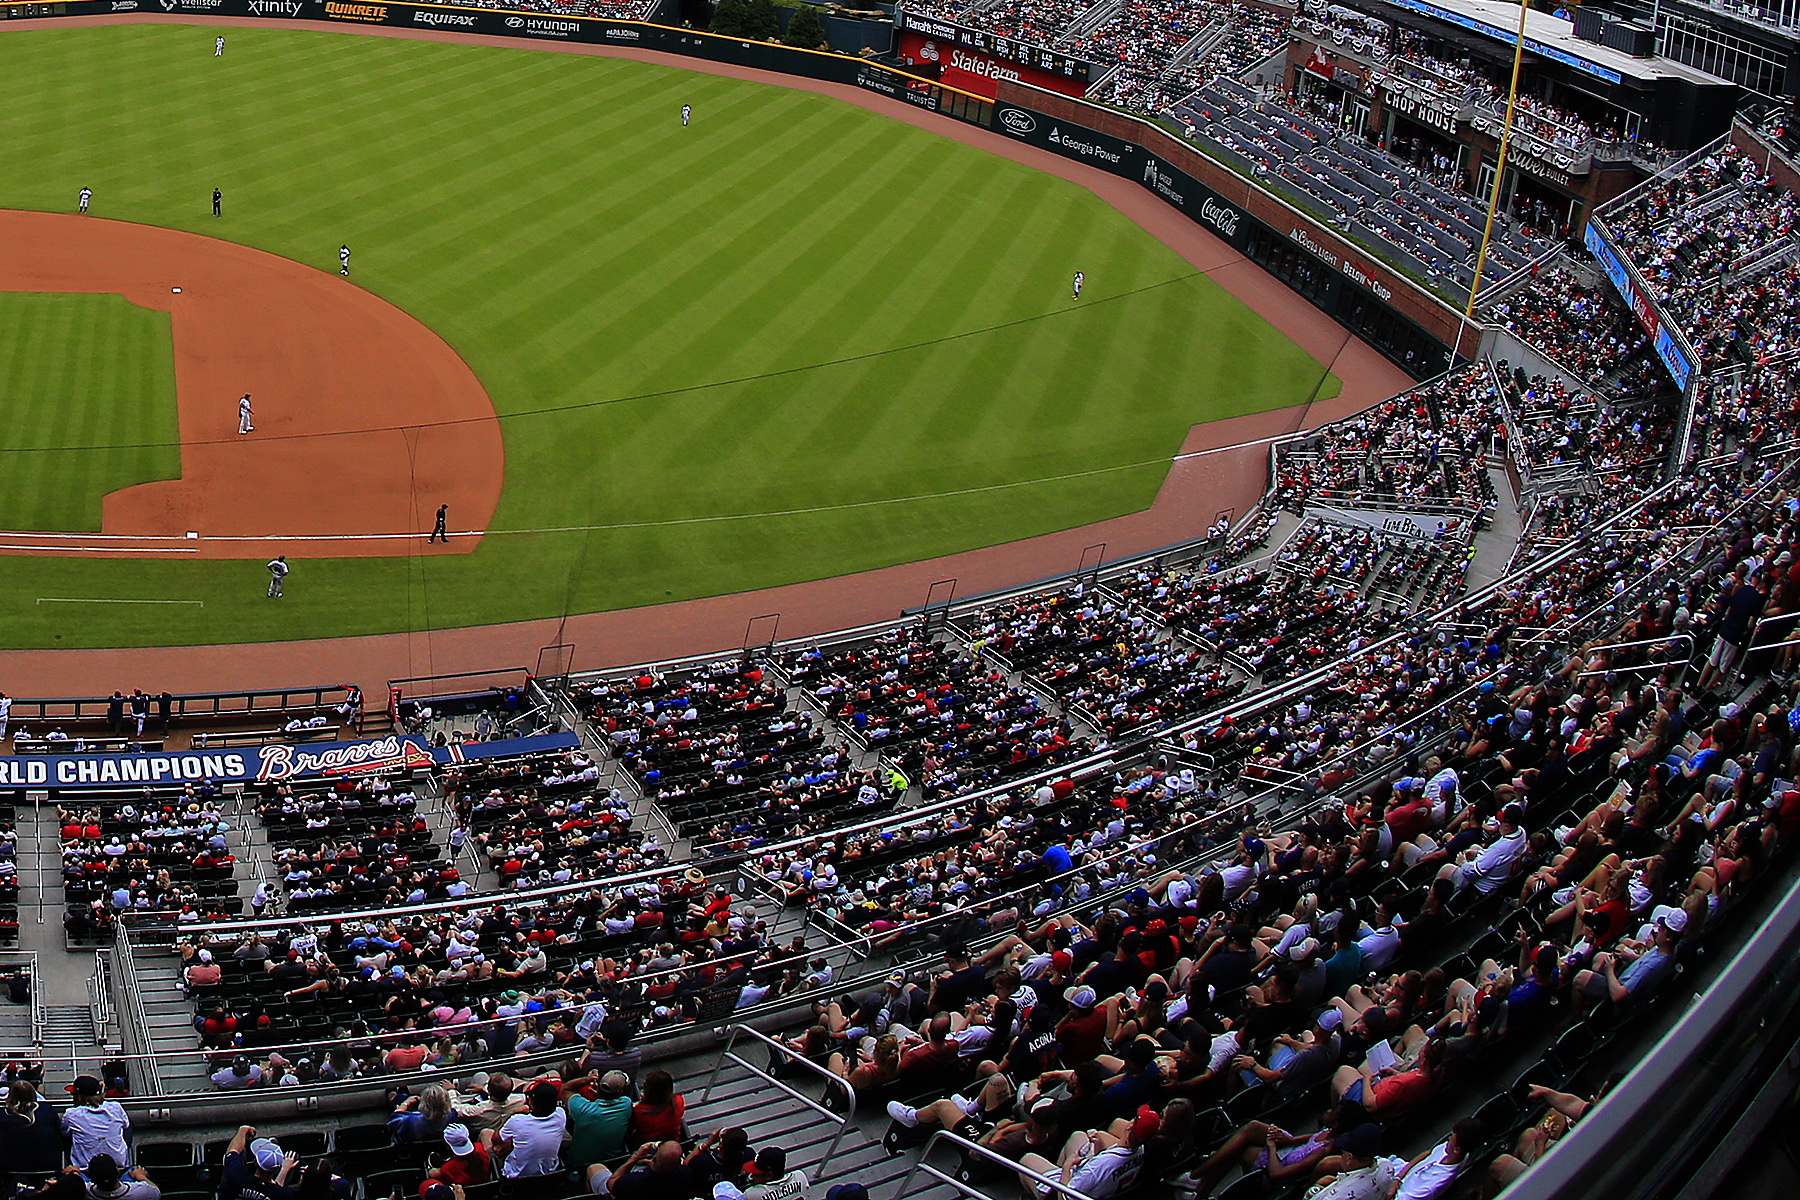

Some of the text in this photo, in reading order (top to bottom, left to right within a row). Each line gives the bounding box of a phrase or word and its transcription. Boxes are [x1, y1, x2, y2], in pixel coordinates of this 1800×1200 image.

[325, 2, 388, 18] QUIKRETE
[413, 11, 475, 26] EQUIFAX
[527, 18, 580, 32] HYUNDAI
[906, 16, 932, 33] Harrah's
[961, 33, 972, 45] NL
[1018, 51, 1029, 61] STL
[906, 92, 928, 105] TRUIST
[1004, 110, 1029, 130] Ford
[1385, 91, 1457, 135] CHOP HOUSE
[1062, 135, 1121, 163] Georgia Power
[1546, 168, 1569, 186] BULLET
[1201, 197, 1240, 237] Coca-Cola
[1318, 247, 1337, 266] LIGHT
[1343, 261, 1392, 301] BELOW CHOP
[56, 754, 246, 784] CHAMPIONS
[256, 736, 400, 782] Braves
